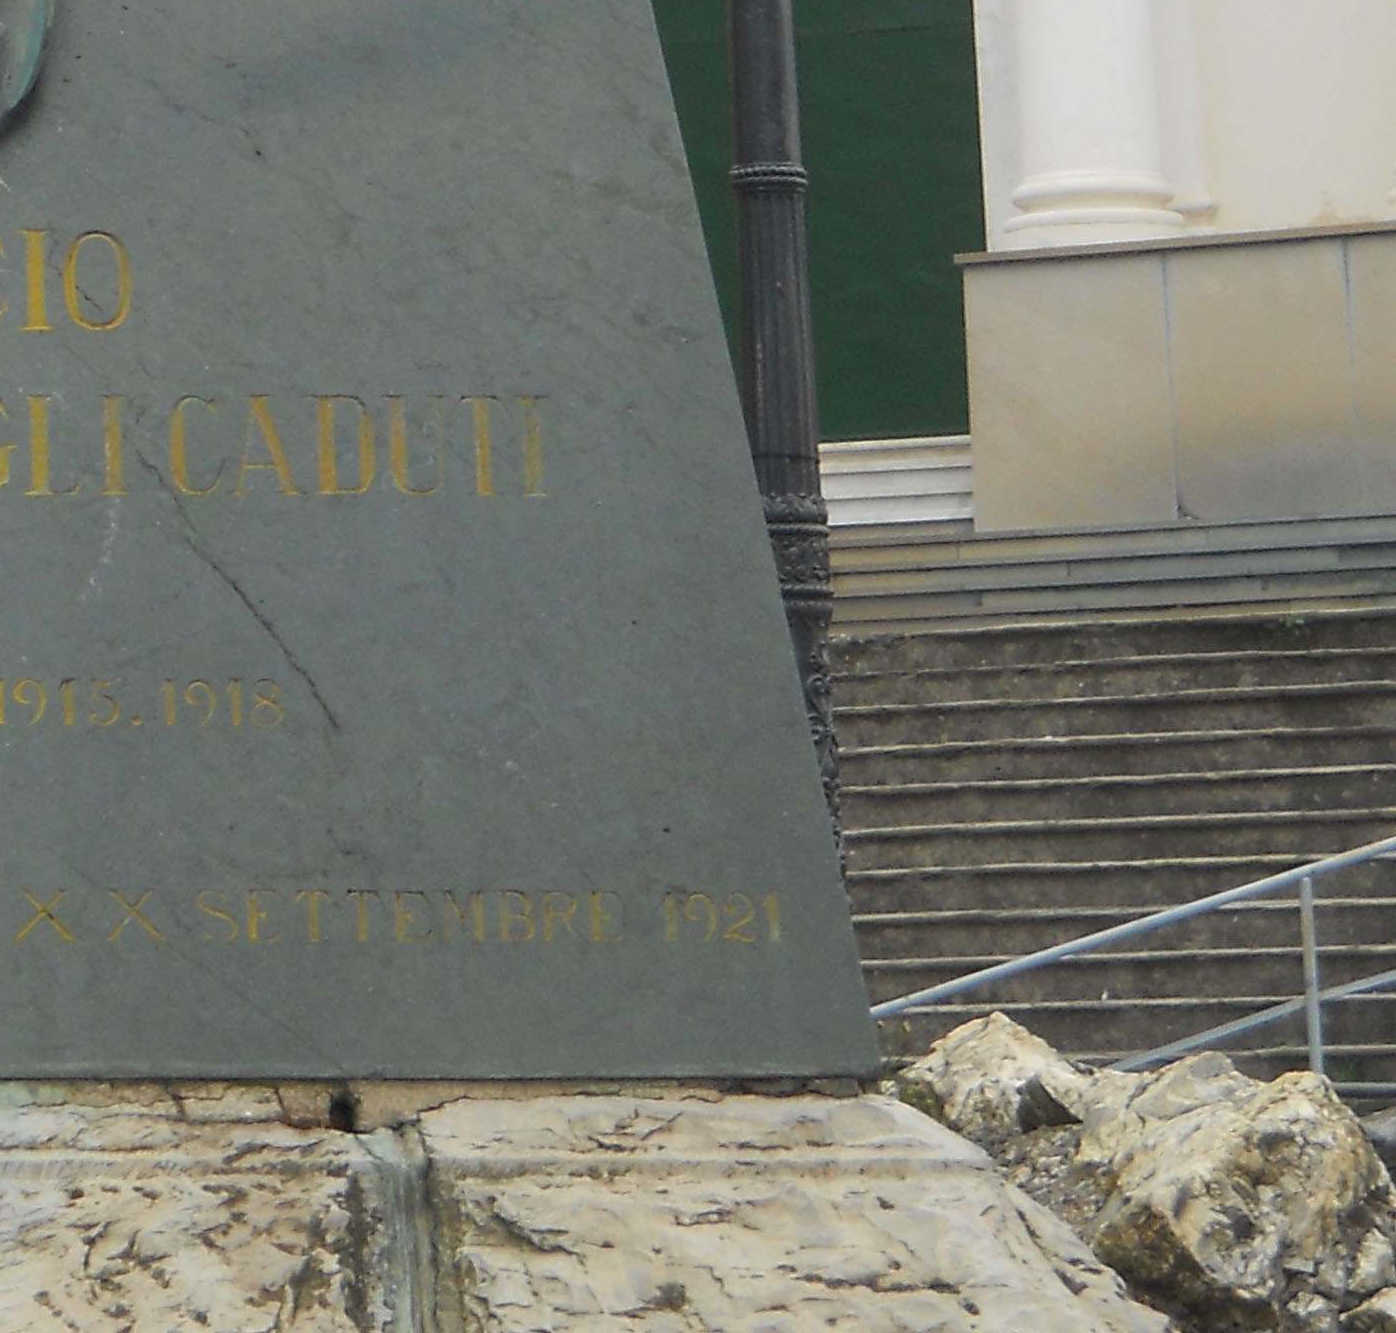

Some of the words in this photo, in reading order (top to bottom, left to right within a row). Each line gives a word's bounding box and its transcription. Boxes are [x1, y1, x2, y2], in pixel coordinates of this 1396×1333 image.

[168, 394, 549, 498] CADUTI
[196, 886, 624, 943] SETTEMBRE
[661, 890, 784, 943] 1921
